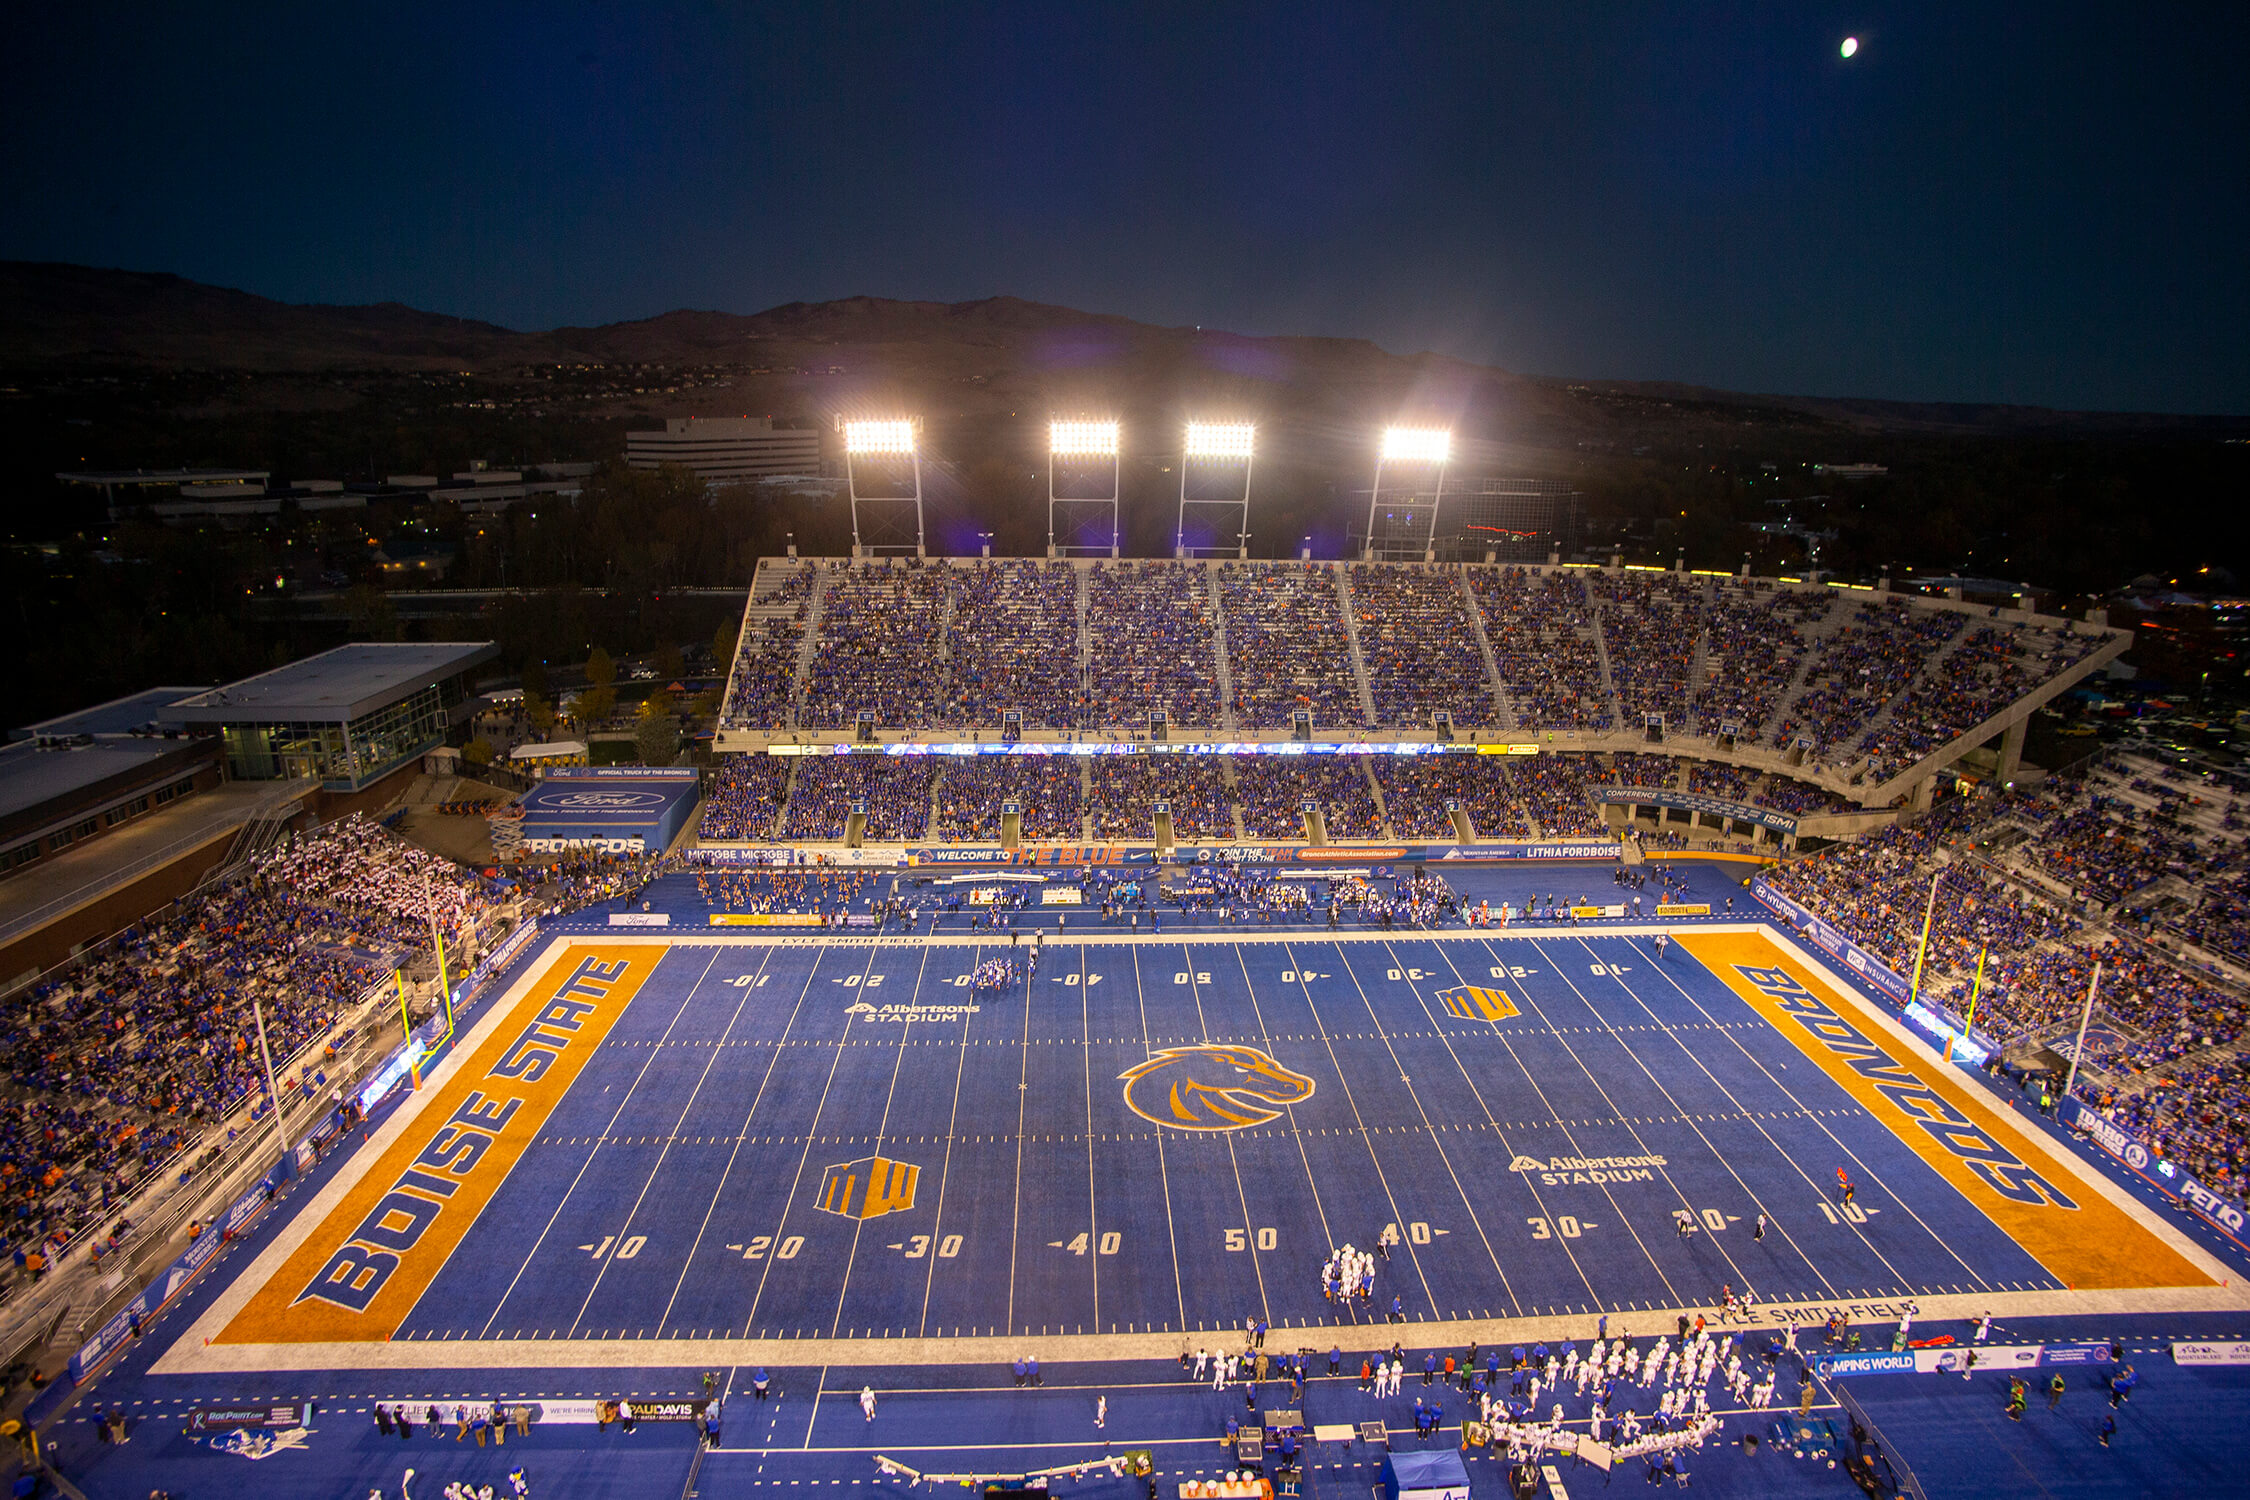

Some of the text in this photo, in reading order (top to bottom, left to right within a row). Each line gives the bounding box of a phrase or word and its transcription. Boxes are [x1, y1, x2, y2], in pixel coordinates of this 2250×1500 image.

[560, 792, 643, 805] Ford
[1606, 790, 1658, 800] CONFERENCE
[1763, 814, 1795, 829] ISMI
[742, 850, 790, 859] MICROBE
[936, 848, 1127, 865] WELCOME TO THE BLUE
[1216, 848, 1241, 856] JOIN
[1243, 848, 1264, 856] THE
[1527, 846, 1621, 858] LITHIAFORDBOISE
[1767, 893, 1798, 920] HYUNDAI
[626, 915, 650, 924] Ford
[1848, 952, 1906, 996] WCF INSURANCE
[878, 1004, 980, 1014] Albertsons
[482, 954, 631, 1084] STATE
[864, 1014, 958, 1022] STADIUM
[1730, 963, 2082, 1211] BRONCOS
[2078, 1107, 2130, 1147] IDAHO
[1549, 1154, 1668, 1172] Albertsons
[1541, 1169, 1654, 1186] STADIUM
[287, 1090, 526, 1314] BOISE
[2180, 1180, 2222, 1208] PET
[2216, 1204, 2245, 1232] IQ
[1704, 1310, 1764, 1326] LYLE
[1770, 1305, 1844, 1322] SMITH
[1864, 1356, 1914, 1370] WORLD
